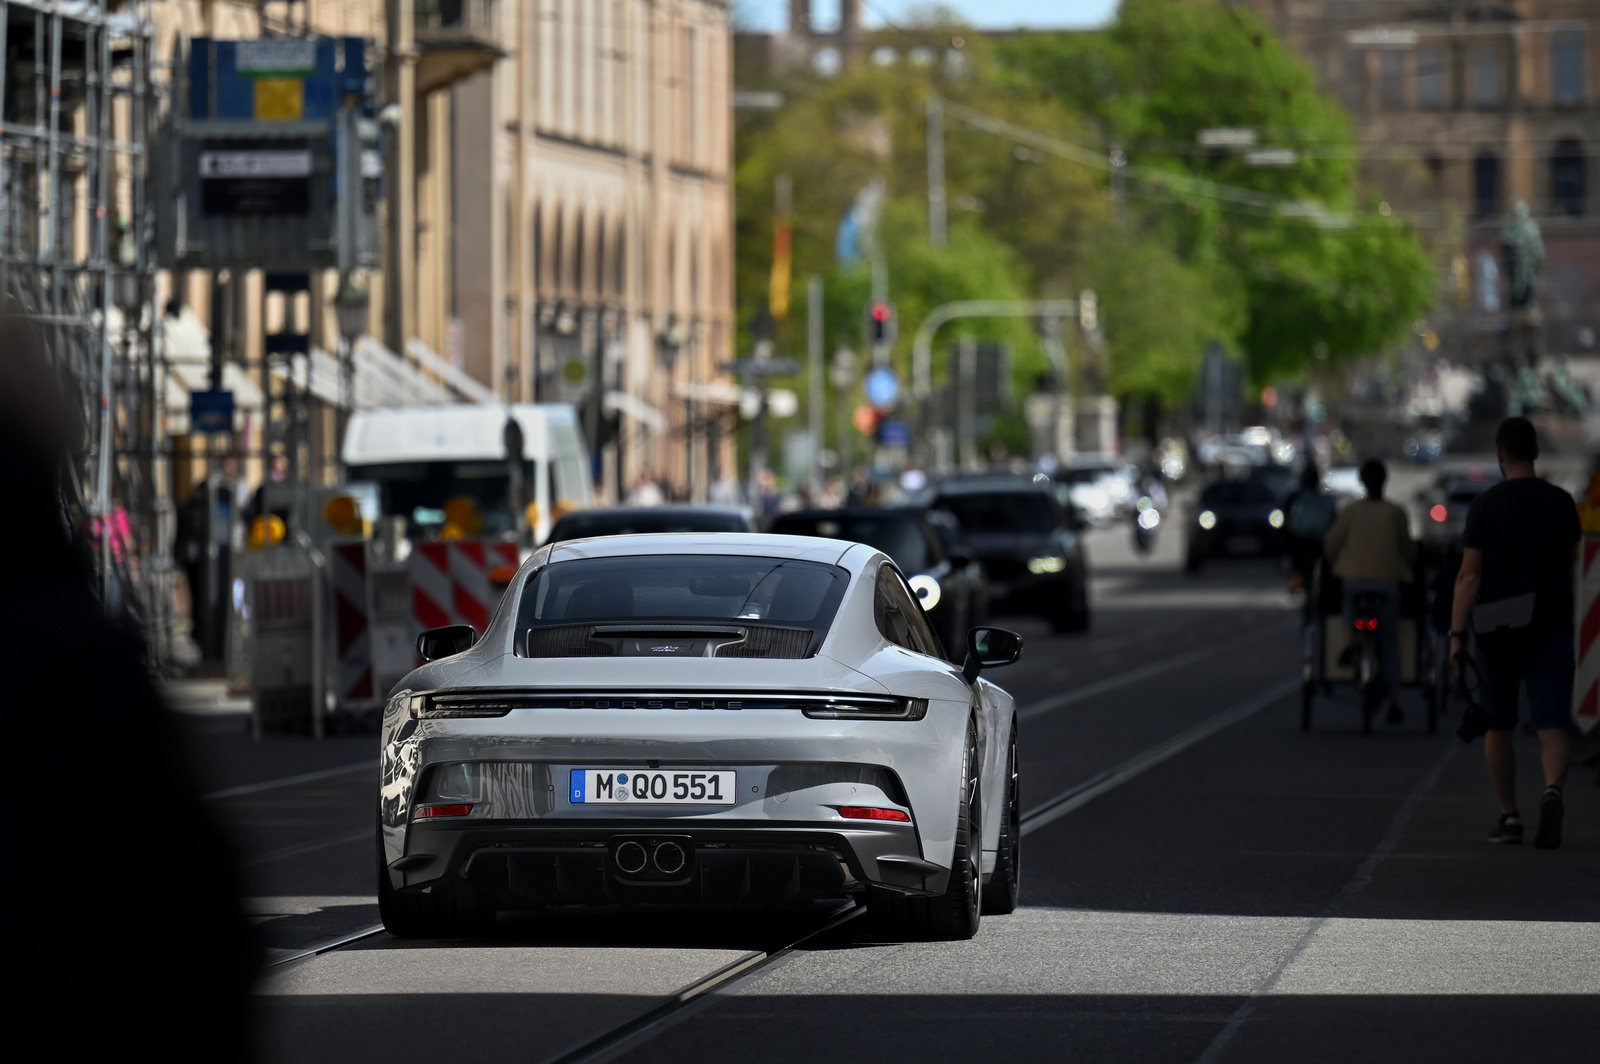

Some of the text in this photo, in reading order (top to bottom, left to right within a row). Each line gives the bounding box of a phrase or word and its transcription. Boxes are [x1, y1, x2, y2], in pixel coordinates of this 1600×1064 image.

[569, 700, 743, 709] PORSCHE
[596, 773, 723, 800] M QO 551
[574, 790, 581, 798] D
